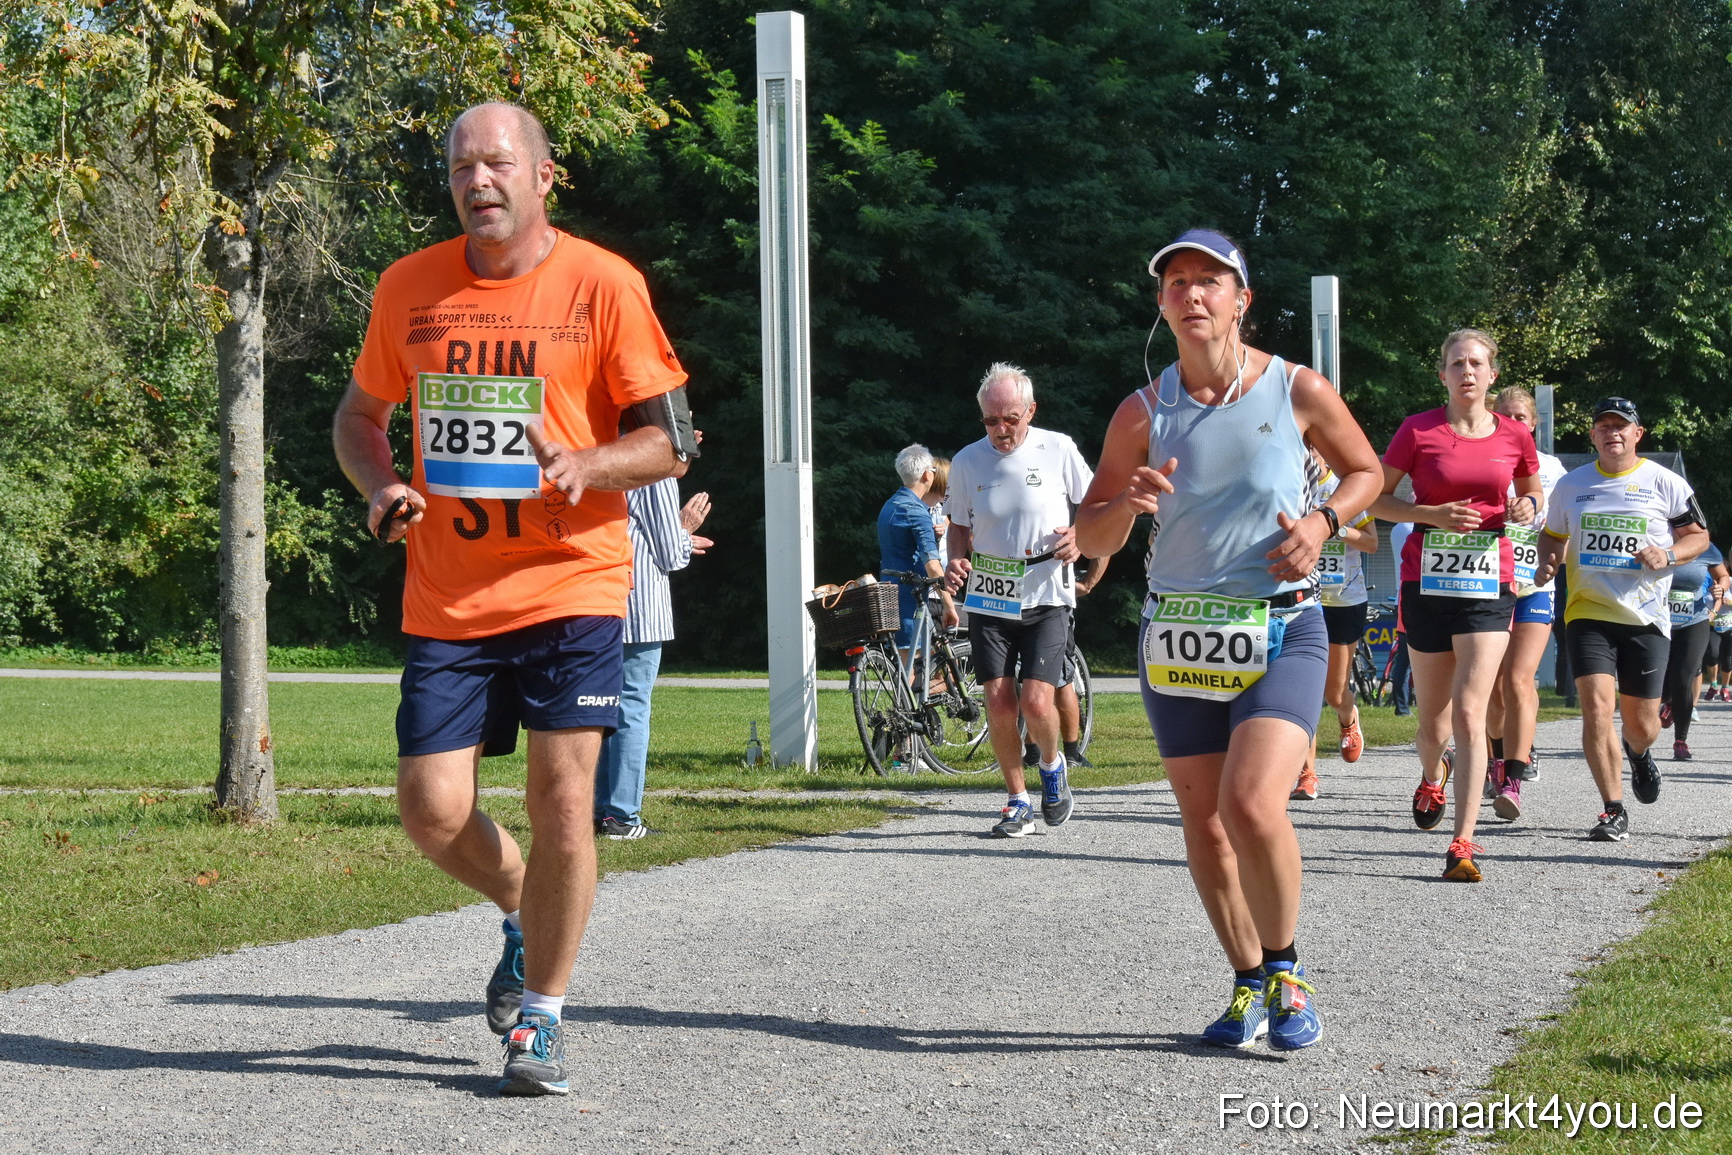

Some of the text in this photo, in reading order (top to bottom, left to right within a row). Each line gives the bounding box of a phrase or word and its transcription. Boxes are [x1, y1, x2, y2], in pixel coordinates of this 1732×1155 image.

[409, 314, 435, 327] URBAN
[437, 313, 466, 325] SPORT
[469, 313, 497, 324] VIBES
[550, 332, 588, 343] SPEED
[446, 340, 537, 378] RUN
[425, 379, 531, 409] BOCK
[429, 417, 525, 456] 2832
[1626, 484, 1639, 492] 20
[1585, 515, 1641, 532] BOCK
[1429, 531, 1492, 549] BOCK
[1505, 527, 1539, 544] OCK
[1586, 533, 1638, 553] 2048
[1317, 557, 1338, 572] 33
[1430, 552, 1491, 575] 2244
[1514, 546, 1536, 565] 98
[1589, 555, 1630, 567] JÜRGEN
[975, 557, 1019, 575] BOCK
[974, 574, 1015, 598] 2082
[1437, 579, 1484, 591] TERESA
[982, 599, 1006, 611] WILLI
[1159, 597, 1258, 622] BOCK
[1668, 601, 1692, 614] 004
[1158, 629, 1253, 664] 1020
[1168, 670, 1244, 689] DANIELA
[577, 695, 615, 706] CRAFT
